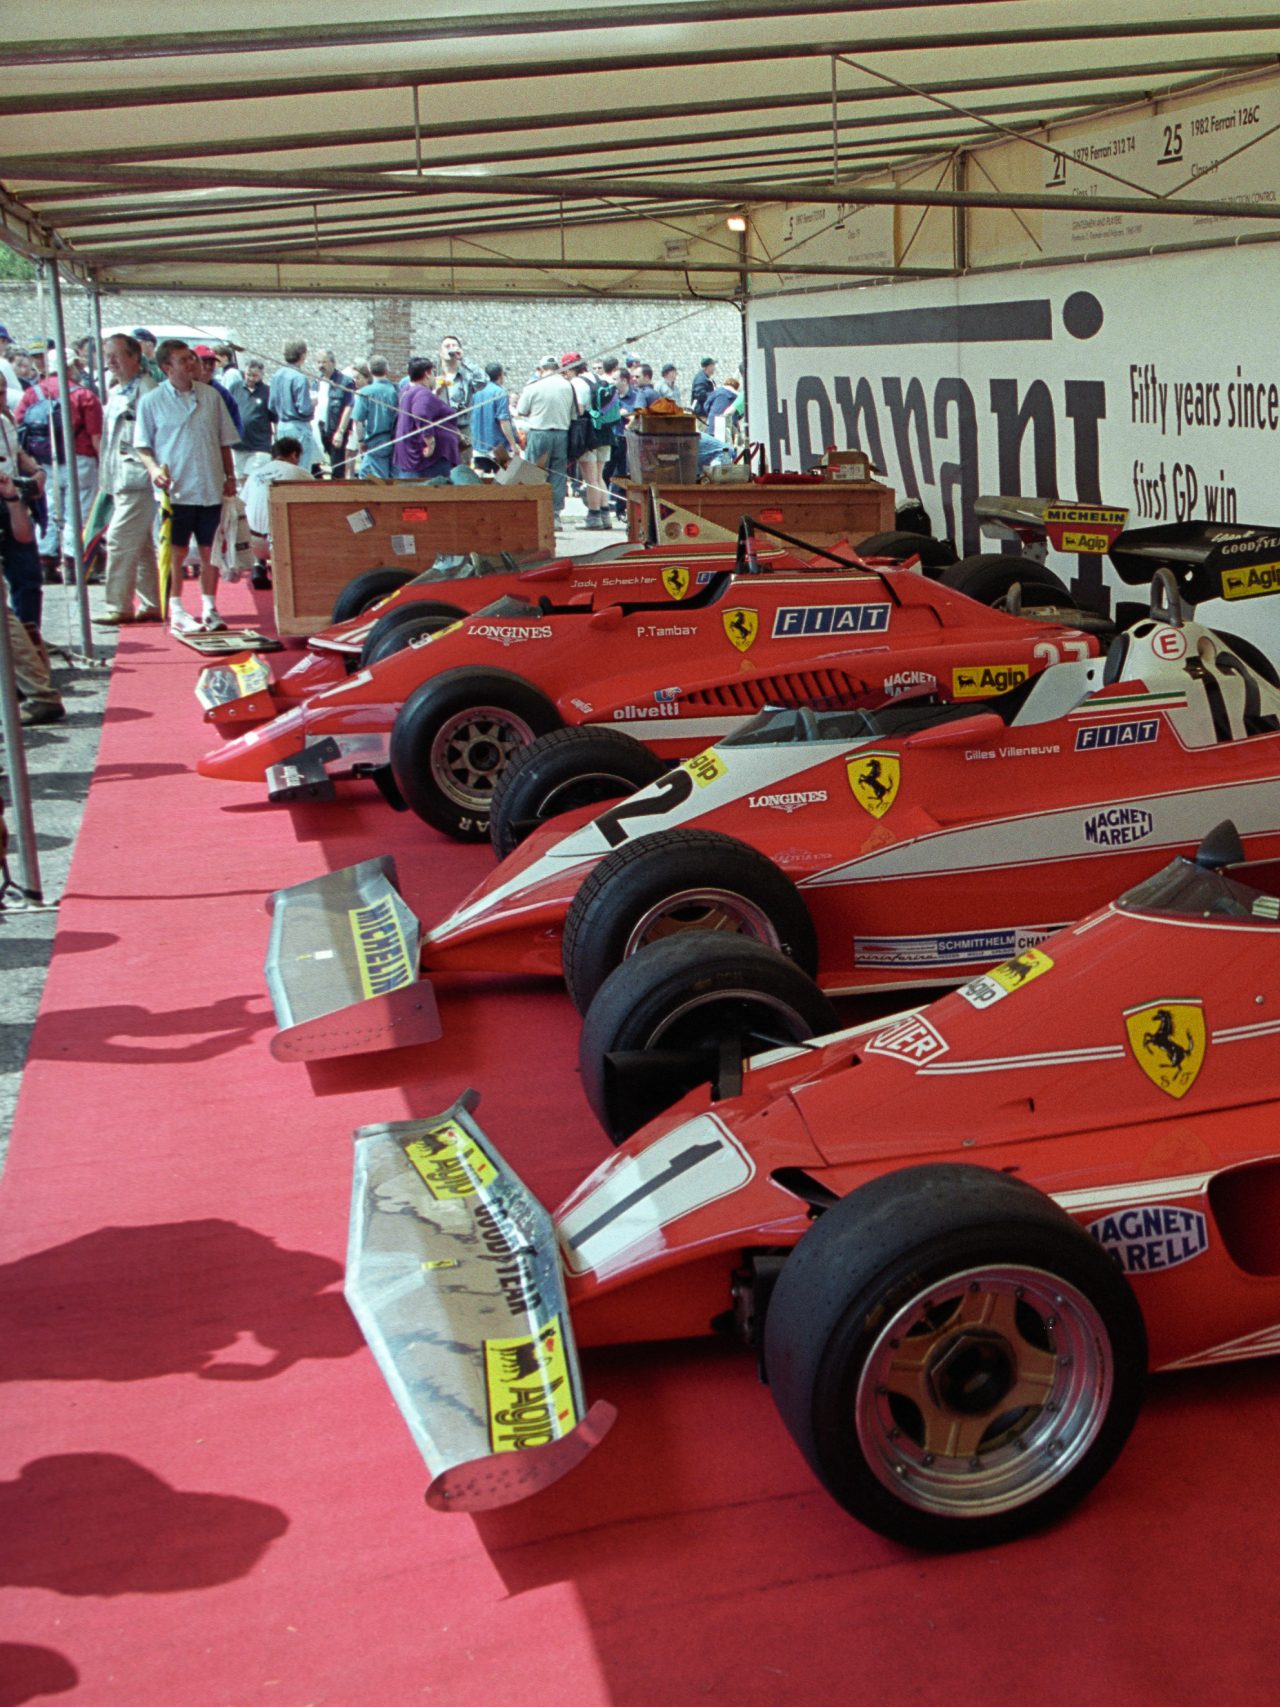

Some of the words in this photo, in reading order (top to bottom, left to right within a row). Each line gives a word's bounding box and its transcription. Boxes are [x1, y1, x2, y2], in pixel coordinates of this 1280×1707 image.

[1191, 117, 1209, 137] 1982
[1210, 110, 1236, 132] Ferrari
[1238, 105, 1261, 127] 126C
[1073, 146, 1089, 161] 1979
[1090, 141, 1112, 161] Ferrari
[1113, 138, 1126, 156] 312
[1127, 136, 1136, 152] T4
[1163, 124, 1183, 157] 25
[1053, 151, 1067, 180] 21
[1130, 364, 1167, 435] Fifty
[1174, 382, 1221, 436] years
[1228, 365, 1279, 430] since
[1133, 460, 1167, 520] first
[1172, 462, 1198, 522] GP
[1204, 469, 1237, 524] win
[1048, 510, 1126, 522] MICHELIN
[1079, 534, 1106, 550] Agip
[570, 580, 597, 588] Jody
[602, 576, 656, 586] Scheckter
[637, 625, 699, 637] P.Tambay
[783, 608, 884, 631] FIAT
[467, 625, 552, 639] LONGINES
[1159, 633, 1179, 654] E
[884, 671, 937, 689] MAGNETI
[979, 668, 1026, 692] Agip
[613, 702, 679, 719] olivetti
[1081, 724, 1154, 747] FIAT
[965, 750, 996, 760] Gilles
[999, 744, 1061, 758] Villeneuve
[688, 754, 719, 781] gip
[749, 791, 827, 808] LONGINES
[1085, 809, 1153, 834] MAGNETI
[1086, 824, 1153, 845] MARELLI
[355, 902, 410, 995] MICHELIN
[965, 977, 997, 1002] gip
[425, 1147, 486, 1197] Agip
[568, 1139, 724, 1252] 1
[474, 1196, 542, 1316] GOODYEAR
[494, 1375, 569, 1452] Agip
